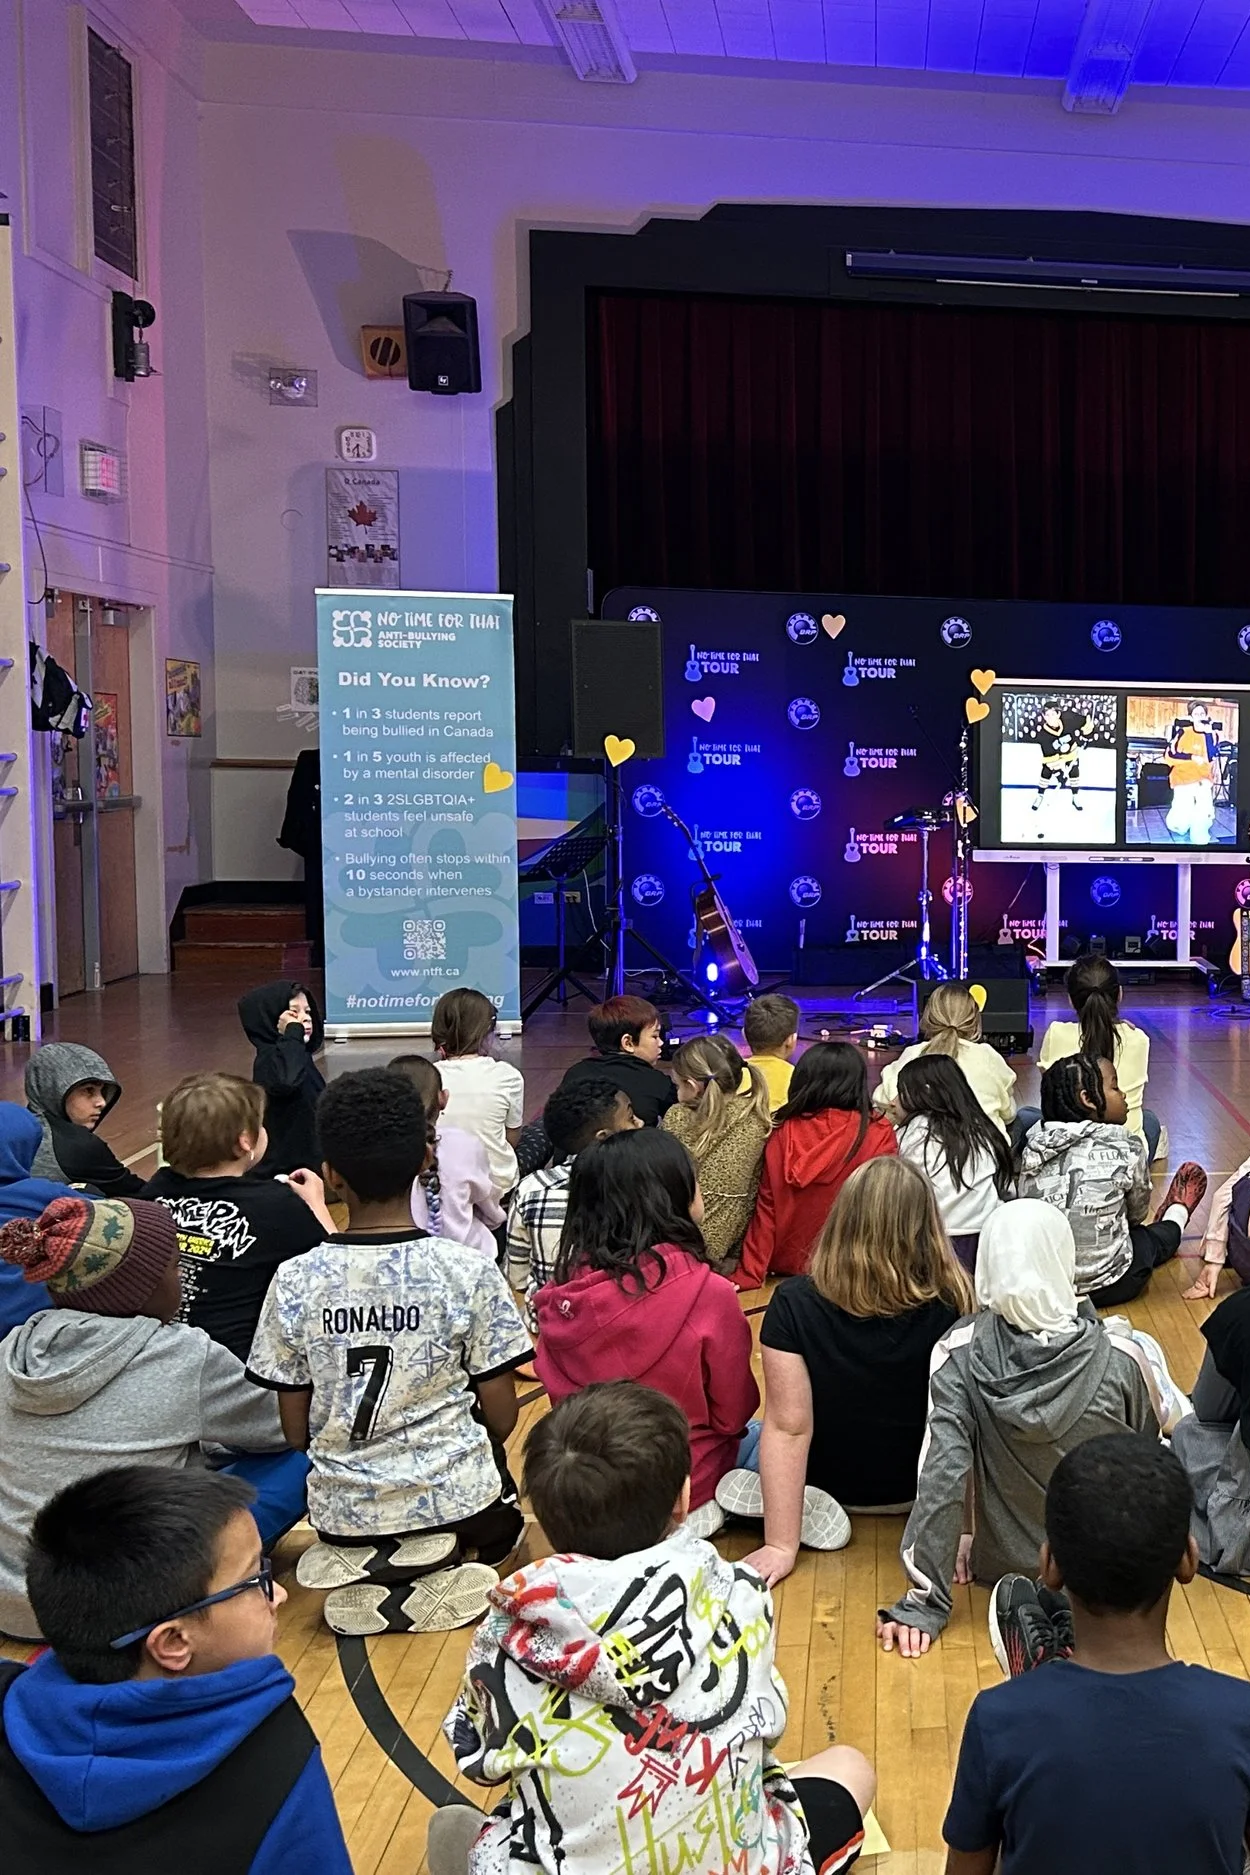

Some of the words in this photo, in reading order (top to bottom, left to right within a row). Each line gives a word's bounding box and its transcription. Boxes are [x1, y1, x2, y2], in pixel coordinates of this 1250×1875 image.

[377, 611, 401, 627] NO
[438, 613, 464, 629] FOR
[469, 613, 500, 630] THAT
[378, 631, 456, 642] ANTI-BULLYING
[378, 640, 422, 649] SOCIETY
[701, 662, 740, 675] TOUR
[858, 667, 897, 679] TOUR
[338, 672, 371, 686] Did
[378, 672, 416, 687] You
[422, 673, 491, 689] Know?
[342, 707, 350, 719] 1
[356, 708, 367, 719] in
[371, 708, 382, 719] 3
[385, 709, 440, 720] students
[443, 710, 482, 723] report
[342, 724, 378, 739] being
[382, 725, 425, 737] bullied
[428, 725, 440, 737] in
[443, 726, 494, 738] Canada
[343, 751, 351, 762] 1
[357, 751, 368, 762] in
[372, 751, 382, 763] 5
[385, 752, 422, 766] youth
[426, 752, 436, 763] is
[439, 752, 491, 764] affected
[703, 753, 741, 766] TOUR
[859, 757, 898, 769] TOUR
[343, 768, 359, 781] by
[362, 770, 371, 779] a
[375, 768, 419, 779] mental
[422, 768, 475, 780] disorder
[344, 794, 354, 805] 2
[358, 794, 369, 805] in
[373, 794, 384, 805] 3
[387, 794, 476, 806] 2SLGBTQIA+
[344, 811, 400, 822] students
[403, 810, 427, 822] feel
[430, 810, 474, 822] unsafe
[344, 827, 357, 838] at
[361, 827, 403, 838] school
[703, 840, 742, 853] TOUR
[859, 843, 898, 854] TOUR
[345, 853, 396, 866] Bullying
[399, 853, 433, 864] often
[436, 854, 471, 866] stops
[474, 853, 511, 864] within
[346, 869, 366, 880] 10
[369, 869, 424, 880] seconds
[428, 869, 463, 880] when
[346, 888, 354, 897] a
[358, 885, 422, 899] bystander
[426, 886, 492, 896] intervenes
[860, 929, 898, 941] TOUR
[390, 967, 460, 977] www.ntft.ca
[346, 993, 505, 1008] #notimeforng
[322, 1305, 420, 1335] RONALDO
[346, 1345, 394, 1442] 7
